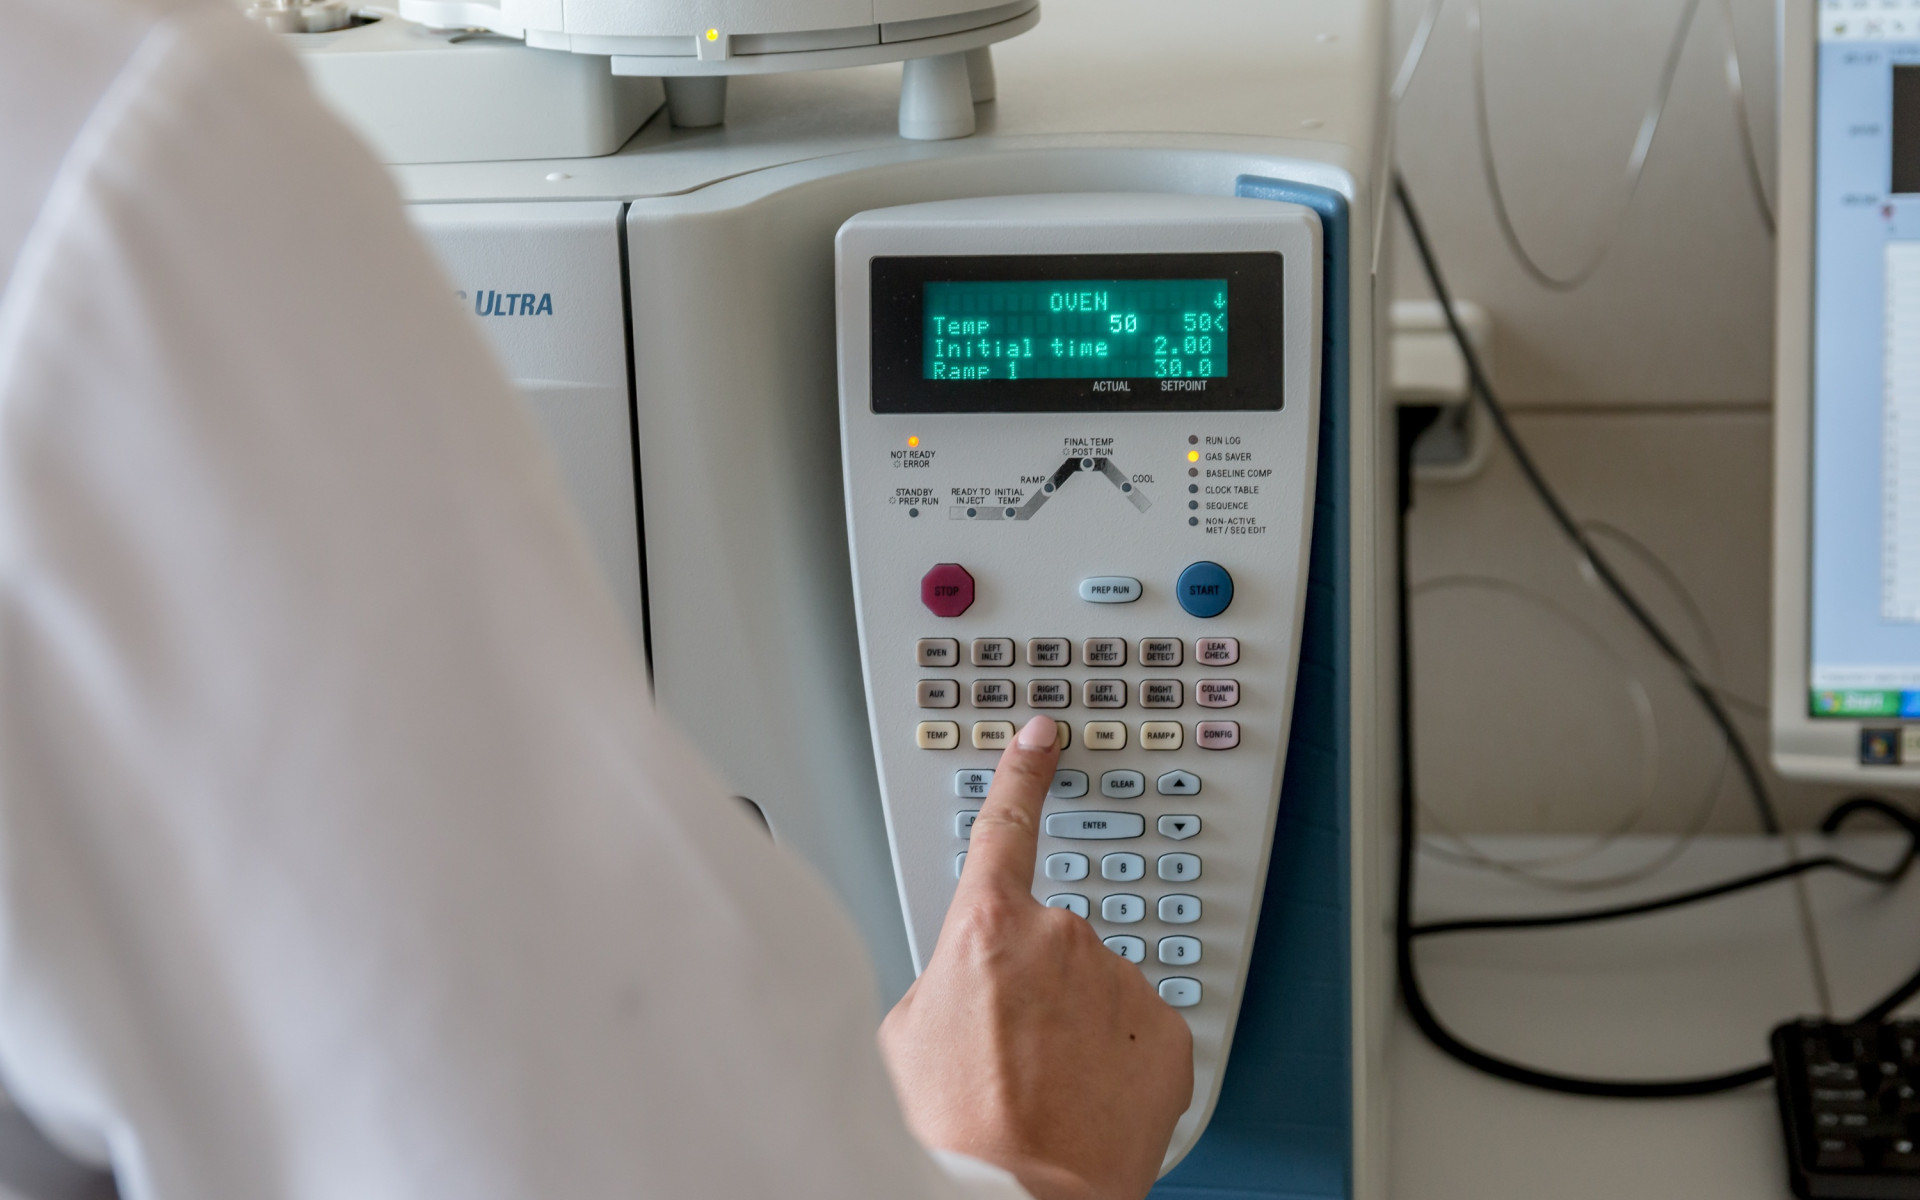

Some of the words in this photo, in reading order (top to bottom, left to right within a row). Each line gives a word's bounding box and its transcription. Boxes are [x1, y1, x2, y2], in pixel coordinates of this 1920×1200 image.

[475, 290, 553, 316] ULTRA
[1050, 292, 1108, 311] OVEN
[933, 316, 989, 335] Temp
[1110, 314, 1137, 333] 50
[934, 339, 1032, 358] Initial
[1051, 339, 1108, 356] time
[1154, 336, 1212, 354] 2.00
[933, 362, 989, 379] Ramp
[1009, 362, 1018, 379] 1
[1154, 359, 1212, 377] 30.0
[1092, 381, 1131, 392] ACTUAL
[1161, 380, 1207, 392] SETPOINT
[1064, 438, 1088, 446] FINAL
[1090, 438, 1114, 446] TEMP
[891, 451, 907, 459] NOT
[909, 451, 935, 459] READY
[1072, 448, 1093, 456] POST
[1205, 453, 1222, 461] GAS
[1225, 453, 1252, 461] SAVER
[903, 460, 930, 468] ERROR
[1206, 469, 1244, 477] BASELINE
[1247, 469, 1272, 477] COMP
[1021, 476, 1045, 484] RAMP
[1132, 475, 1154, 483] COOL
[951, 488, 977, 496] READY
[980, 488, 991, 496] TO
[994, 488, 1024, 496] INITIAL
[1205, 486, 1231, 494] CLOCK
[1234, 486, 1259, 494] TABLE
[899, 497, 919, 505] PREP
[922, 497, 939, 505] RUN
[956, 497, 985, 505] INJECT
[998, 497, 1021, 505] TEMP
[1205, 502, 1248, 510] SEQUENCE
[1205, 518, 1256, 526] NON-ACTIVE
[1205, 526, 1223, 534] MET
[1231, 526, 1246, 534] SEQ
[1248, 526, 1266, 534] EDIT
[934, 586, 959, 596] STOP
[1091, 585, 1111, 594] PREP
[1113, 585, 1130, 594] RUN
[1189, 585, 1220, 596] START
[984, 644, 1000, 652] LEFT
[1037, 644, 1060, 652] RIGHT
[1095, 644, 1112, 652] LEFT
[1149, 644, 1171, 652] RIGHT
[1207, 643, 1226, 651] LEAK
[926, 648, 947, 657] OVEN
[982, 652, 1002, 660] INLET
[1038, 652, 1059, 661] INLET
[1090, 652, 1118, 661] DETECT
[1147, 652, 1174, 661] DETECT
[1204, 651, 1230, 660] CHECK
[984, 685, 1000, 694] LEFT
[1037, 685, 1060, 694] RIGHT
[1095, 685, 1112, 694] LEFT
[1150, 685, 1172, 694] RIGHT
[1201, 684, 1234, 693] COLUMN
[929, 690, 945, 698] AUX
[977, 693, 1008, 702] CARRIER
[1033, 693, 1065, 702] CARRIER
[1090, 693, 1118, 702] SIGNAL
[1147, 694, 1175, 703] SIGNAL
[1209, 693, 1228, 702] EVAL
[926, 731, 948, 740] TEMP
[981, 731, 1005, 740] PRESS
[1096, 732, 1114, 740] TIME
[1147, 731, 1175, 740] RAMP#
[1204, 730, 1233, 739] CONFIG
[971, 774, 982, 782] ON
[970, 785, 984, 793] YES
[1111, 780, 1135, 789] CLEAR
[1083, 821, 1107, 830] ENTER
[1064, 863, 1071, 873] 7
[1120, 863, 1127, 873] 8
[1177, 863, 1183, 873] 9
[1120, 904, 1127, 914] 5
[1177, 904, 1184, 914] 6
[1121, 946, 1128, 956] 2
[1177, 946, 1184, 957] 3
